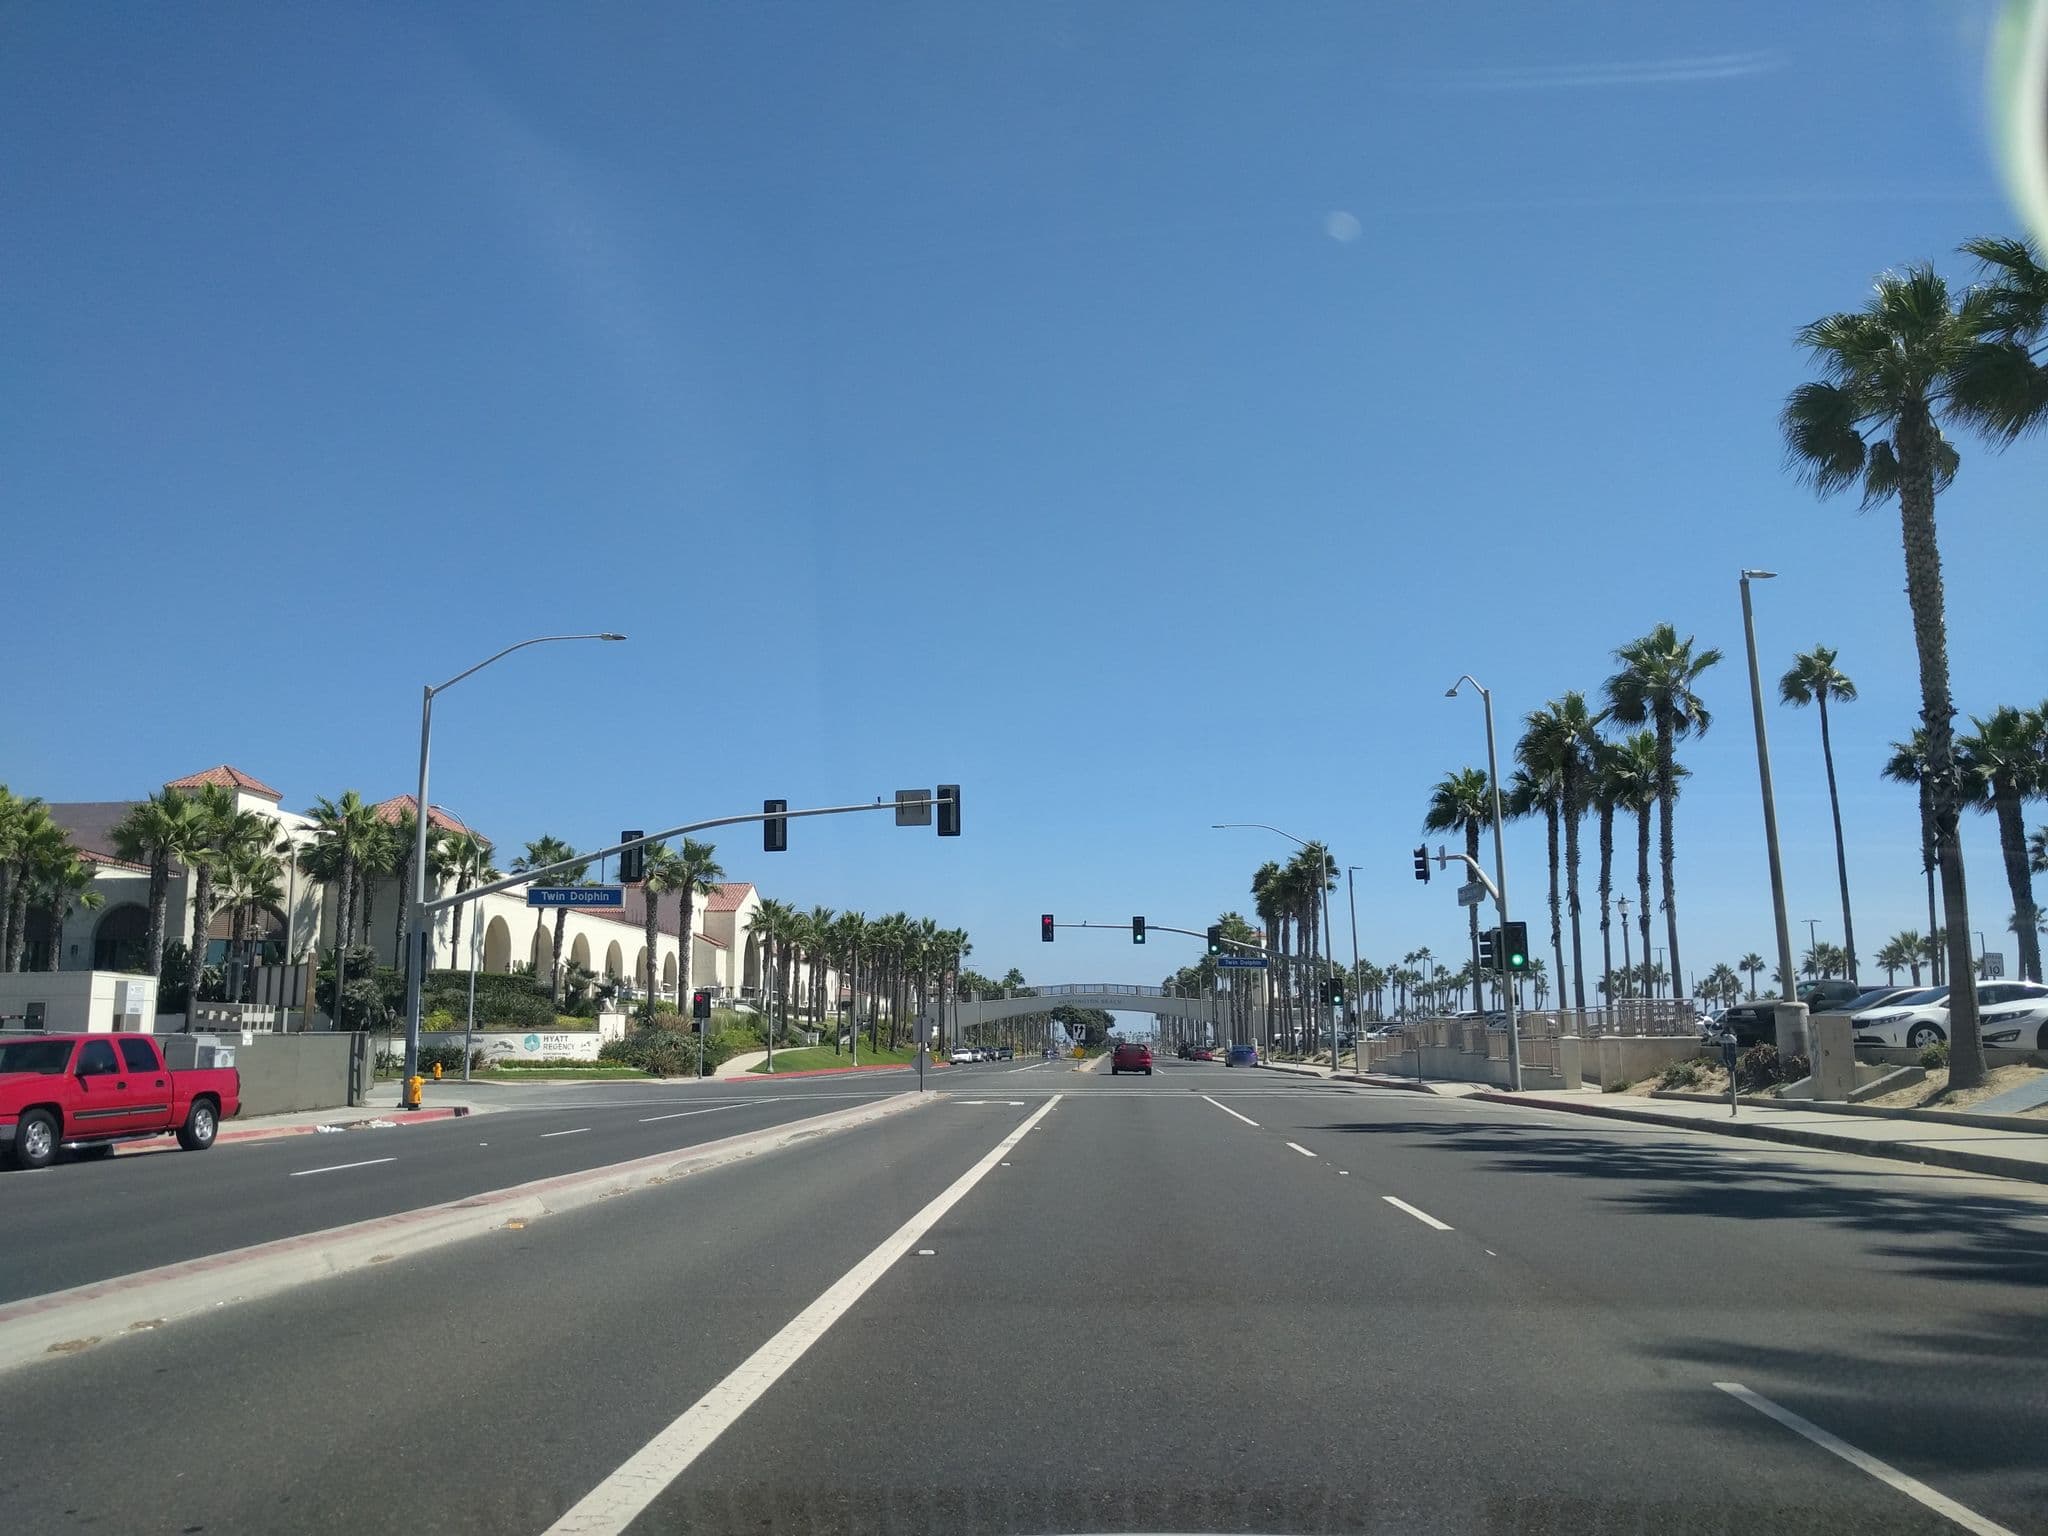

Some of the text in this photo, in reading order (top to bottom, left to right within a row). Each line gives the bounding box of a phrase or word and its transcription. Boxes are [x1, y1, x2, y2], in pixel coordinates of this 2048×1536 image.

[541, 891, 609, 903] Twin Dolphin
[1989, 965, 2000, 975] 10
[543, 1034, 569, 1043] HYATT
[543, 1043, 575, 1051] REGENCY
